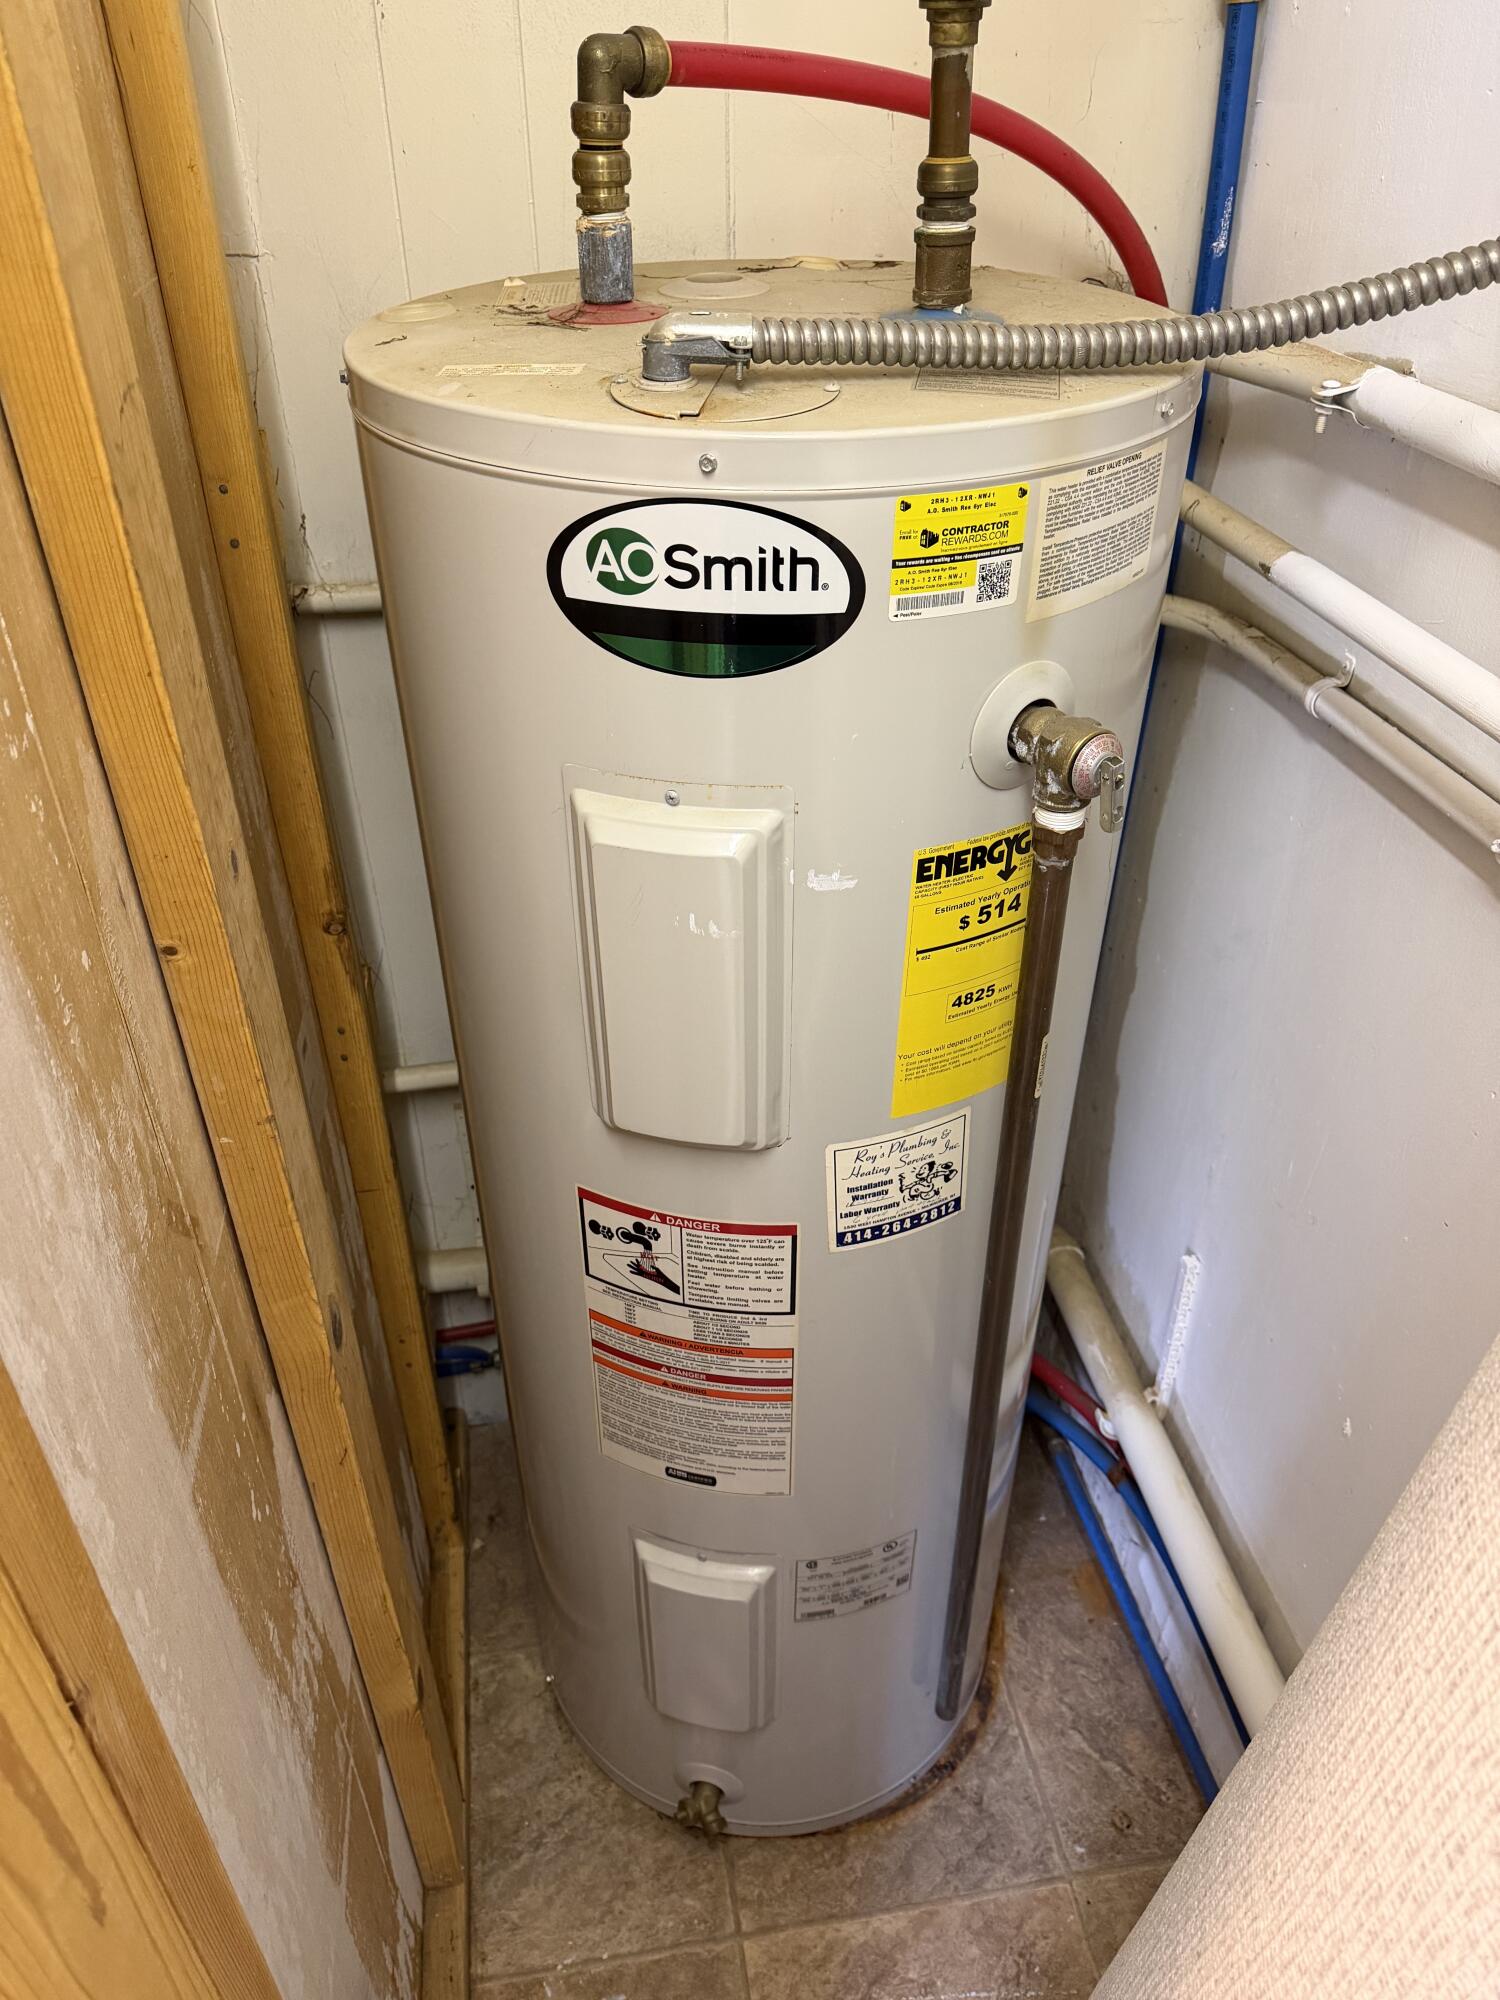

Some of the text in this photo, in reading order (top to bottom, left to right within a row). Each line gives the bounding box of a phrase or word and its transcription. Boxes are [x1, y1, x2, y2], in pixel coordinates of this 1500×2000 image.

[1087, 452, 1142, 476] RELIEF VALVE OPENING
[942, 520, 1009, 537] CONTRACTOR
[942, 530, 1008, 546] REWARDS.COM
[664, 544, 819, 592] Smith
[928, 844, 954, 854] Government
[935, 899, 976, 914] Estimated
[978, 891, 1001, 903] Yearly
[959, 893, 1021, 931] $ 514
[969, 941, 985, 949] Range
[951, 984, 995, 1008] 4825
[948, 995, 1010, 1020] Estimated Yearly Energy
[917, 1048, 932, 1056] cost
[934, 1044, 945, 1052] will
[947, 1037, 972, 1049] depend
[983, 1026, 997, 1038] your
[854, 1129, 952, 1163] Roy's Plumbing &
[842, 1164, 890, 1180] Heating
[895, 1153, 935, 1169] Service,
[847, 1179, 893, 1194] Installation
[852, 1189, 889, 1201] Warranty
[840, 1210, 862, 1219] Labor
[864, 1201, 900, 1215] Warranty
[873, 1215, 896, 1224] HAMPTON
[897, 1209, 915, 1217] AVENUE
[666, 1216, 720, 1232] DANGER
[843, 1201, 955, 1244] 414-264-2812
[687, 1250, 712, 1258] Children,
[689, 1292, 724, 1300] Temperature
[647, 1333, 744, 1356] WARNING ADVERTENCIA
[671, 1368, 707, 1380] DANGER
[671, 1383, 707, 1396] WARNING
